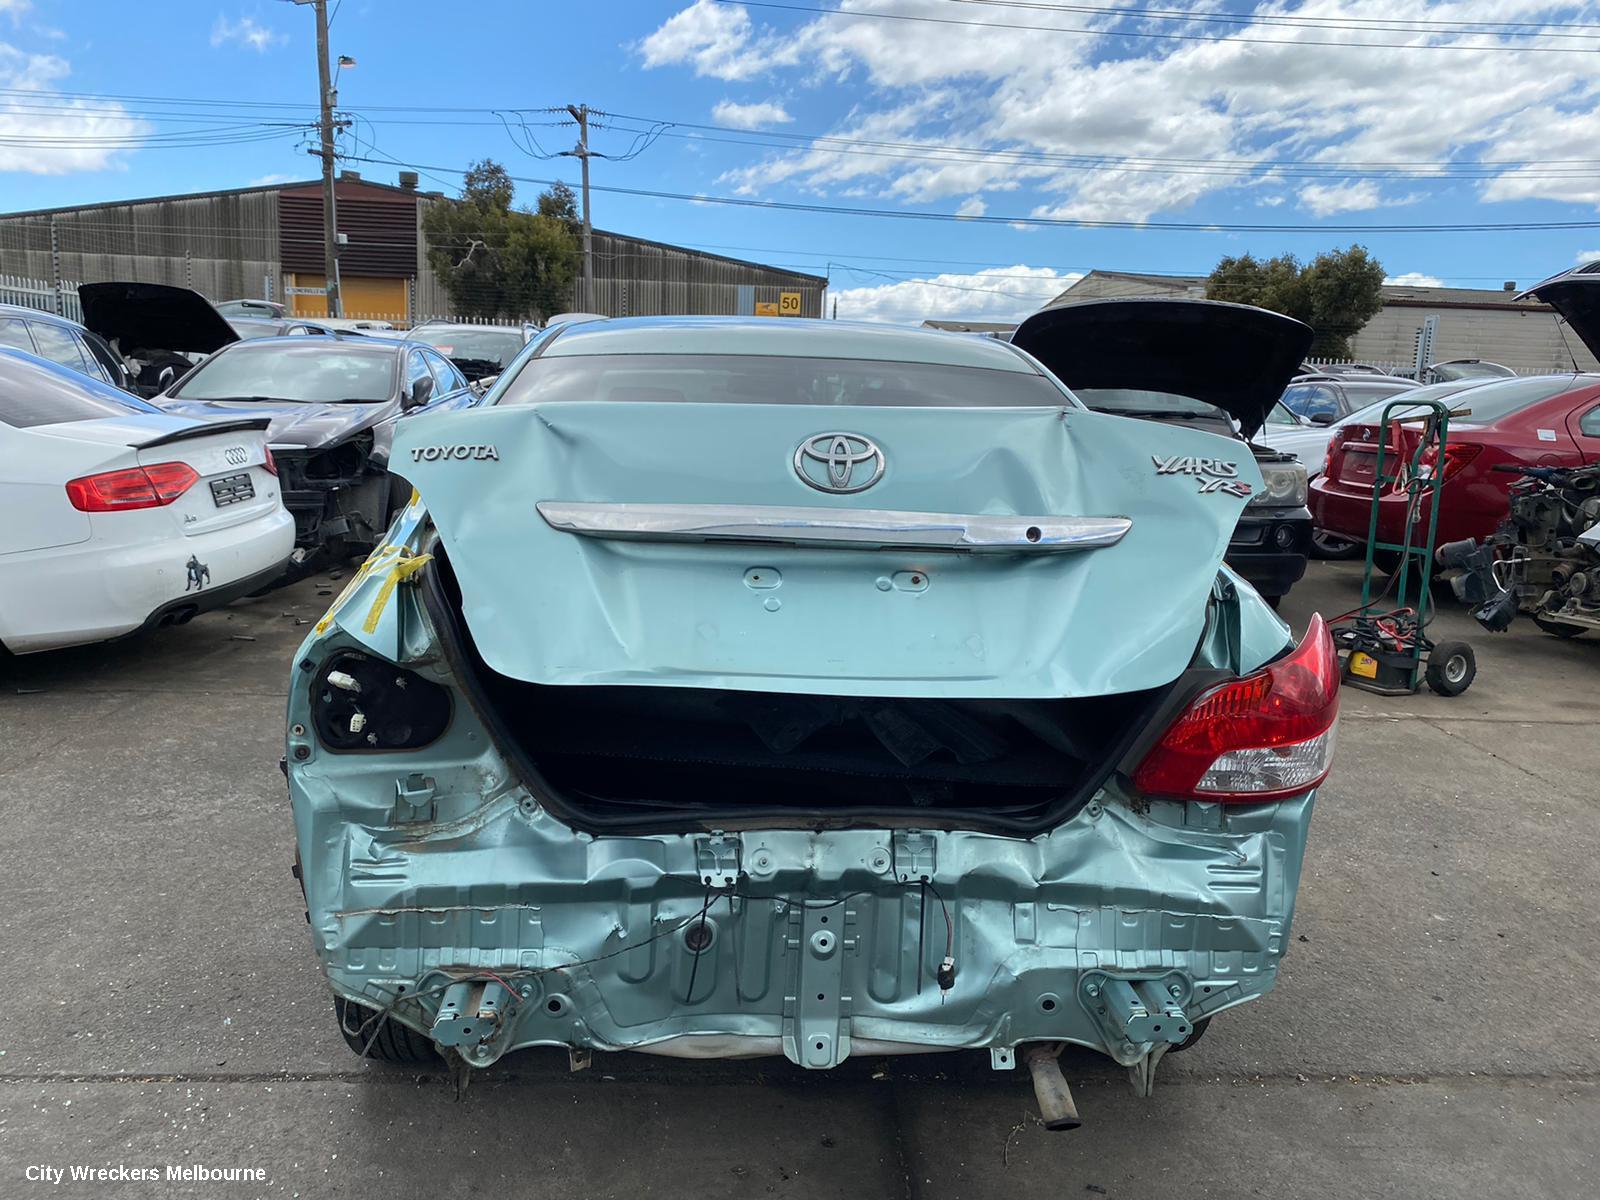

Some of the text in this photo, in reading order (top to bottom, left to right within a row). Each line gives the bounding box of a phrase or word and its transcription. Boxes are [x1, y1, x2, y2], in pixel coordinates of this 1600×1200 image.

[782, 297, 799, 310] 50
[411, 444, 499, 462] TOYOTA
[1151, 455, 1239, 478] YARIS
[1196, 476, 1252, 498] YRS
